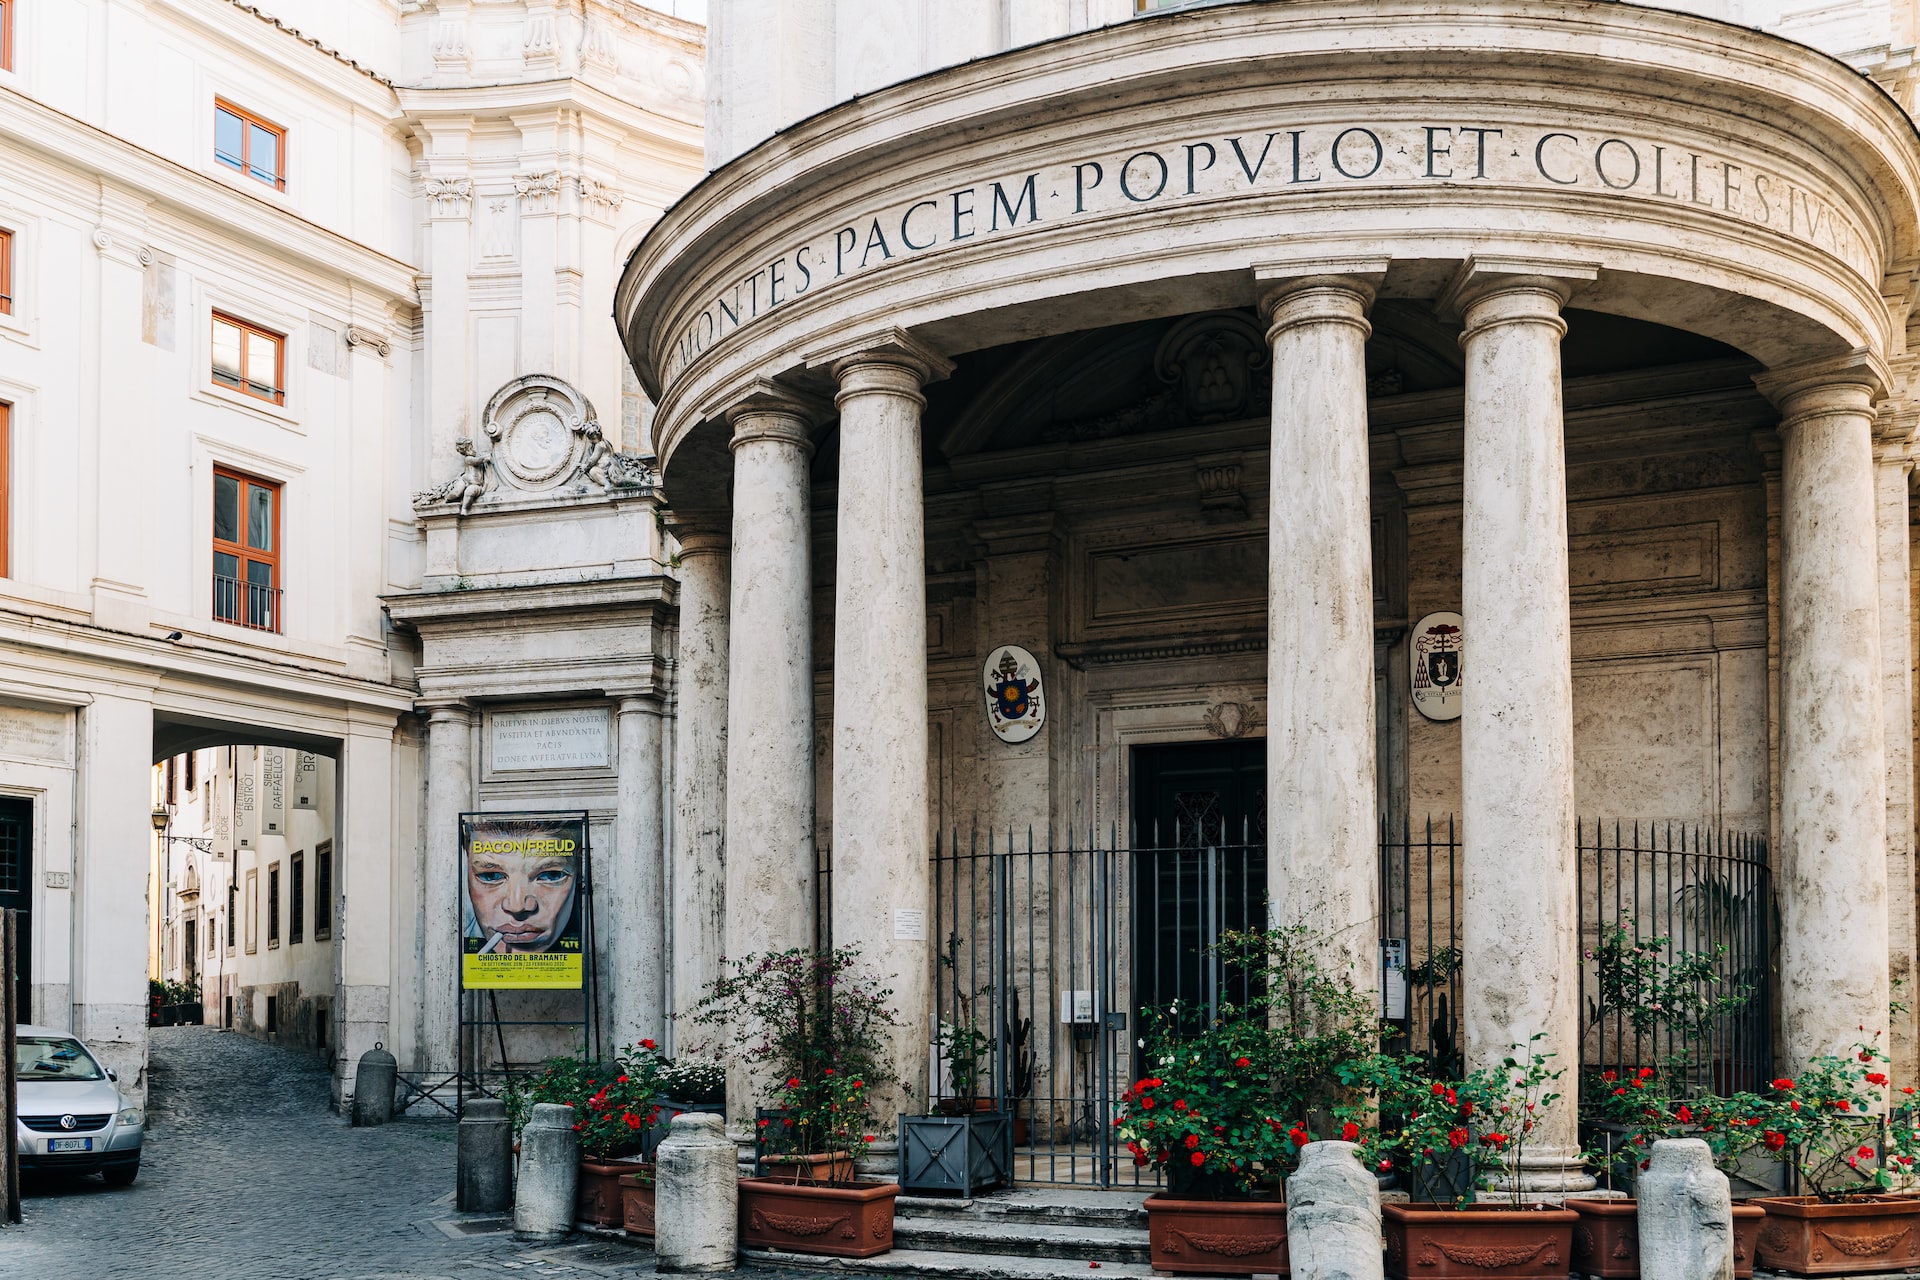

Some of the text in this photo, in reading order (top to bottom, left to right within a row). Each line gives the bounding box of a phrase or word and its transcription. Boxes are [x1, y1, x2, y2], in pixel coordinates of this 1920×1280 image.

[679, 246, 811, 367] MONTES
[834, 172, 1043, 279] PACEM
[1071, 127, 1384, 215] POPVLO
[1421, 126, 1503, 180] ET
[1534, 133, 1771, 224] COLLES
[494, 714, 608, 729] ORIETVR IN DIEBVS NOSTRIS
[534, 730, 544, 738] ET
[545, 727, 601, 738] ABVNDANTIA
[537, 741, 562, 750] PACIS
[497, 755, 528, 763] DONEC
[580, 752, 603, 760] LVNA
[264, 756, 273, 787] SIBILLE
[244, 773, 254, 811] BISTROT
[273, 755, 283, 810] RAFFAELLO
[236, 777, 244, 828] CAFFETTERIA
[221, 815, 229, 841] STORE
[53, 873, 65, 885] 13
[478, 954, 513, 962] CHIOSTRO
[514, 954, 527, 962] DEL
